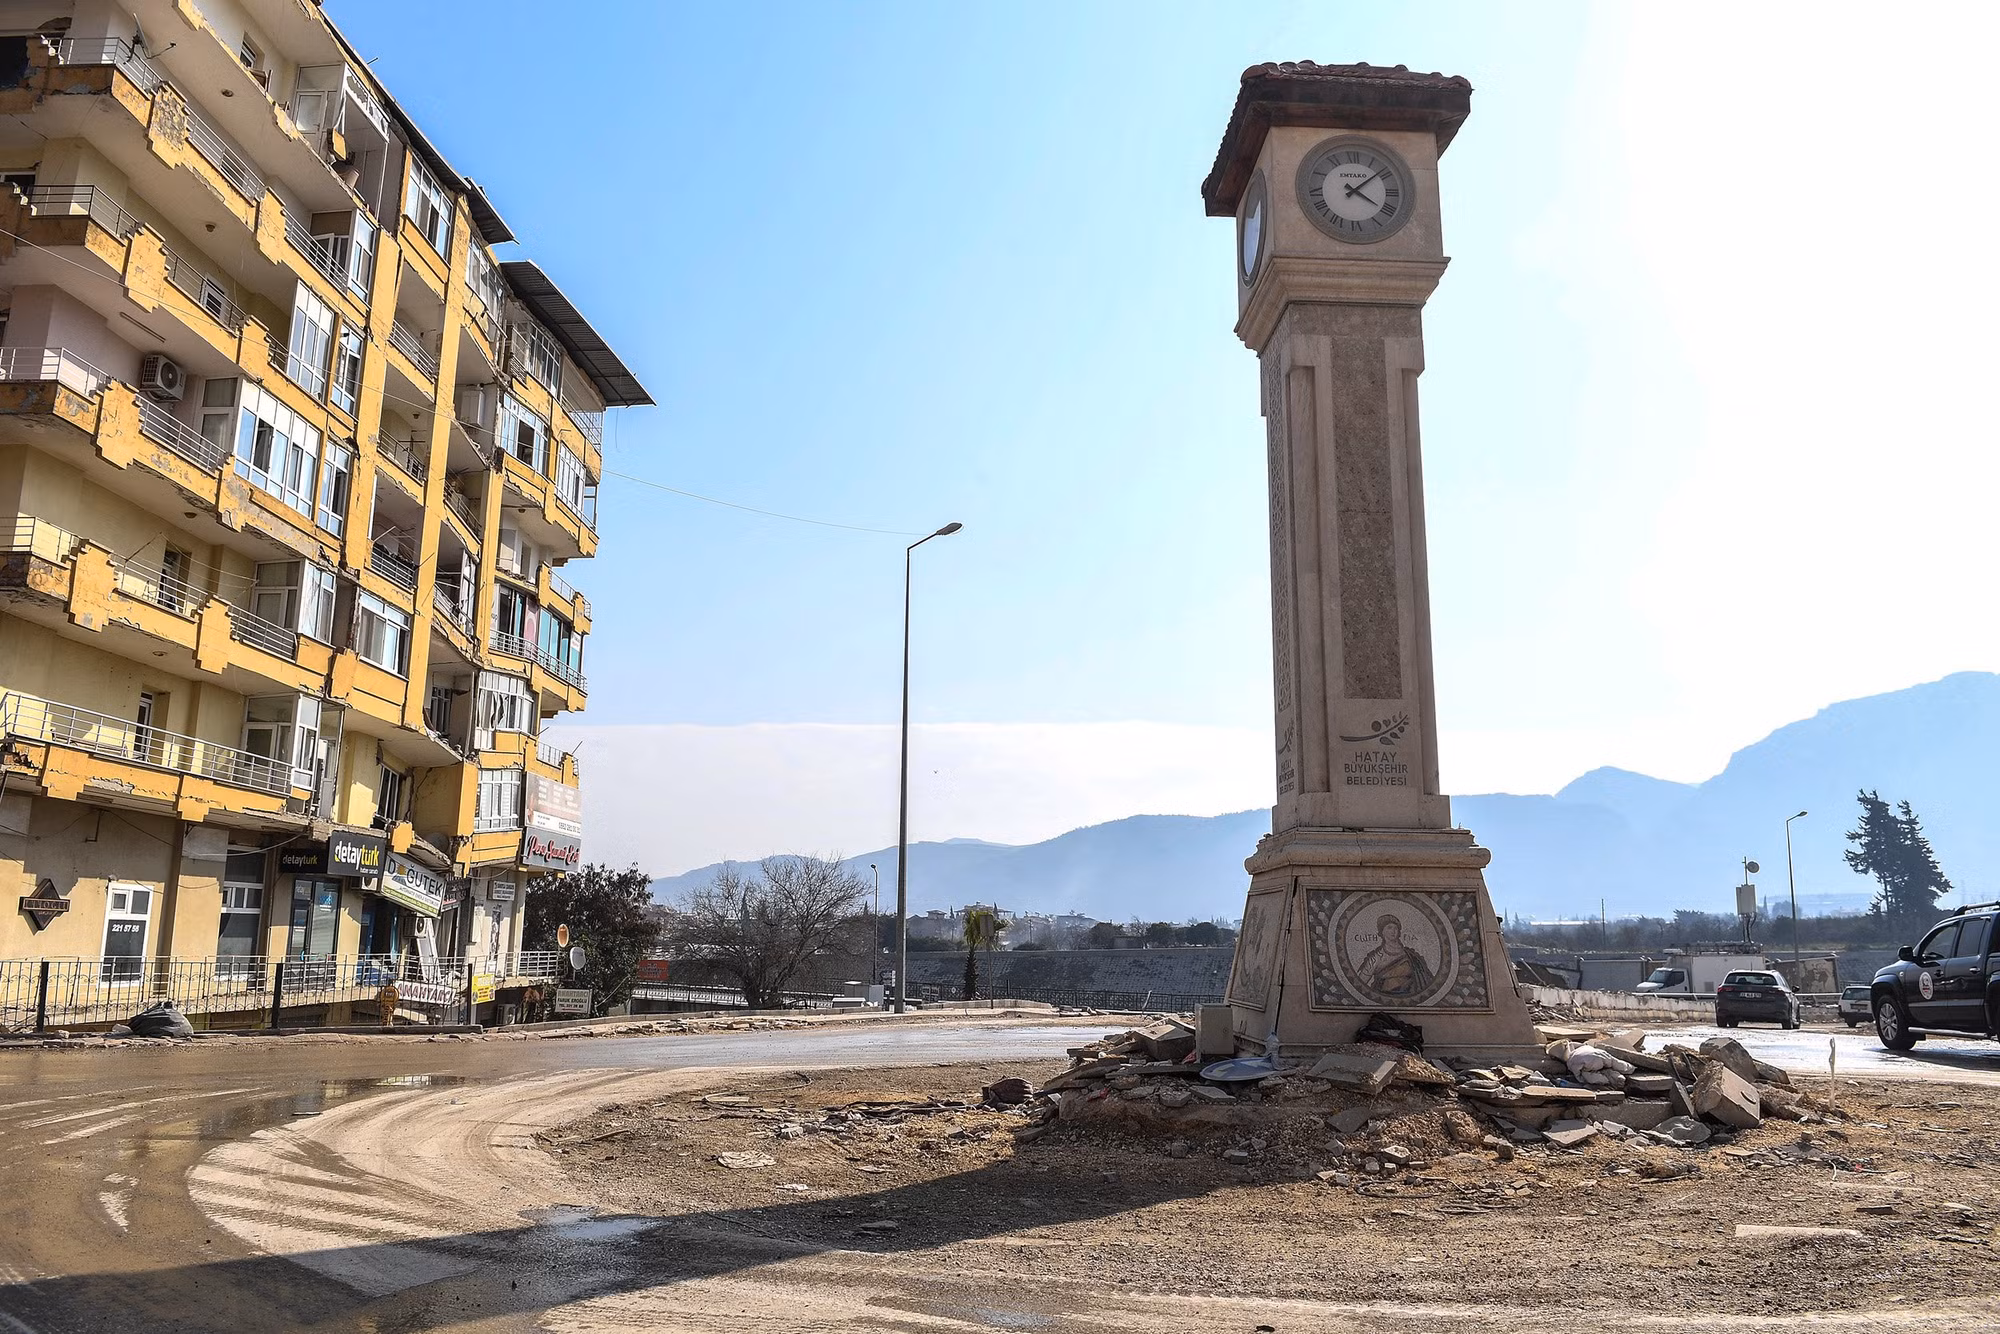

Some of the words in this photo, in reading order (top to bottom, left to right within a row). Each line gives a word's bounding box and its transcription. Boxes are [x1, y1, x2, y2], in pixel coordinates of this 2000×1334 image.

[1354, 751, 1397, 763] HATAY
[1344, 761, 1408, 775] BÜYÜKŞEHİR
[1346, 775, 1407, 786] BELEDİYESİ
[112, 924, 123, 932] 221
